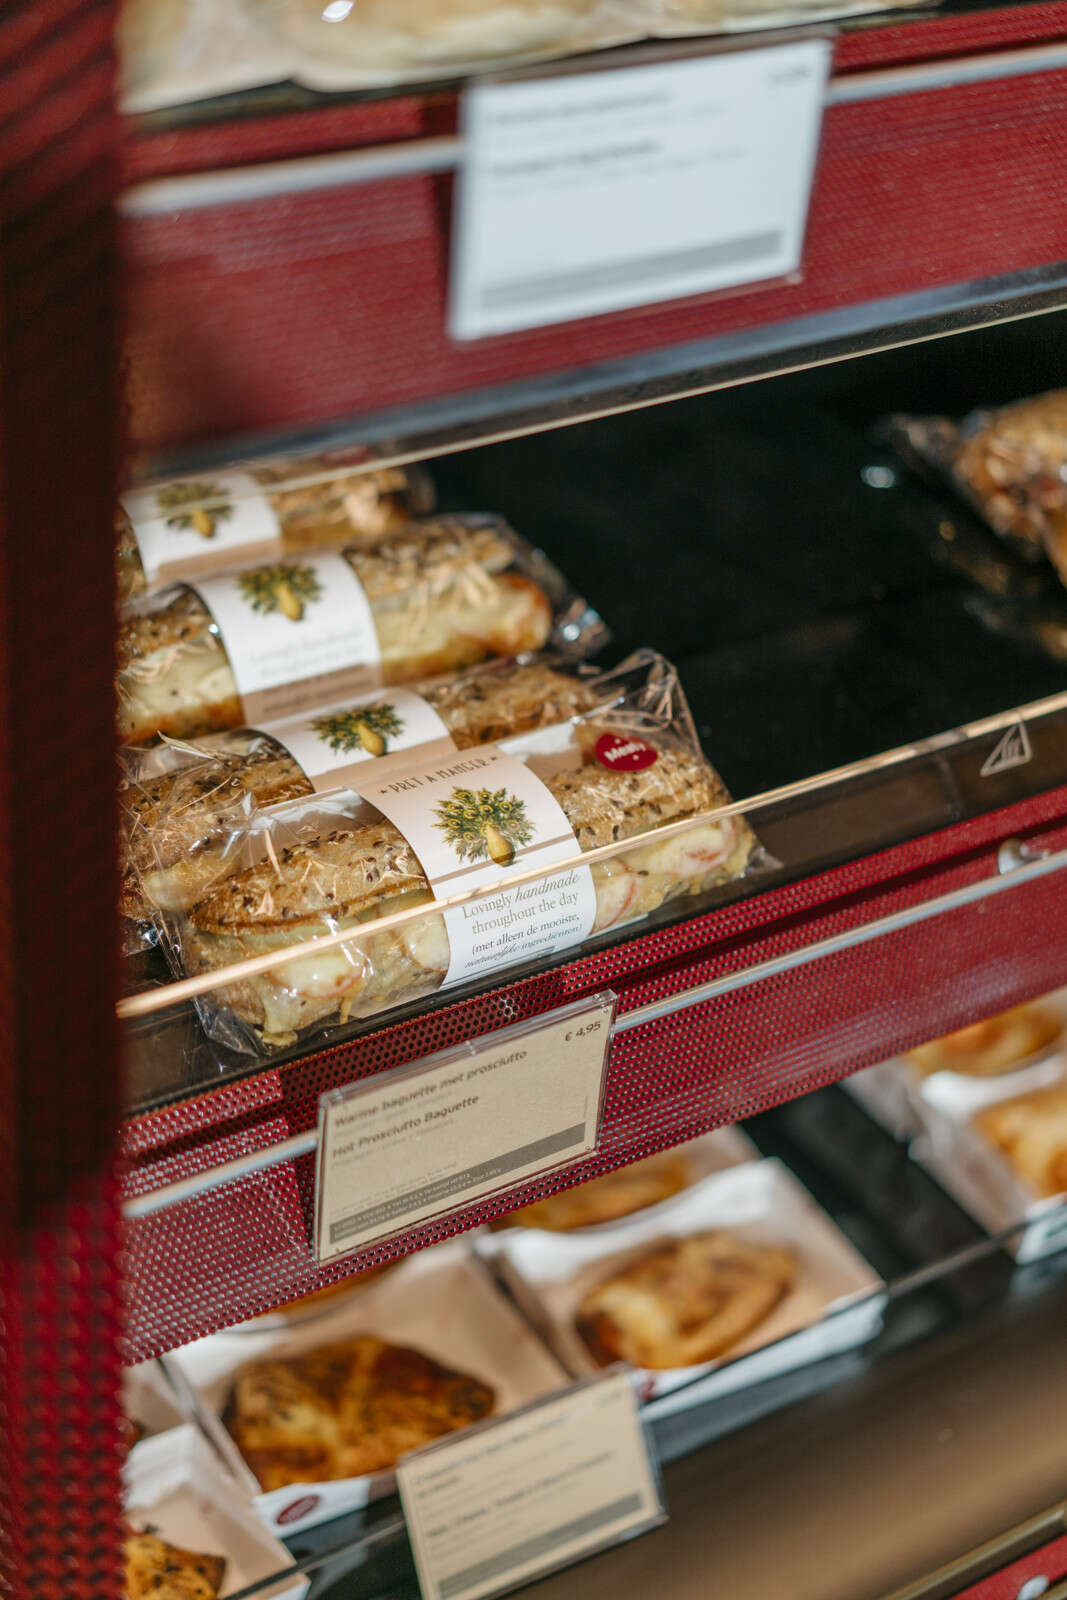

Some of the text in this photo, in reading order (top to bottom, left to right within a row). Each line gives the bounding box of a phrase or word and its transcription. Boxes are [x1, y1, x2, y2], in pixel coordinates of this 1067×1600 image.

[388, 758, 490, 793] PRET A MANGER
[462, 870, 579, 919] Lovingly handmade
[472, 892, 579, 934] throughout the day
[472, 913, 580, 956] (met alleen de mooiste,
[575, 1021, 601, 1036] 4,95
[335, 1105, 378, 1128] Warme
[381, 1084, 437, 1111] baguette
[440, 1073, 464, 1090] met
[466, 1050, 528, 1081] prosciutto
[332, 1141, 355, 1158] Hot
[358, 1117, 422, 1146] Prosciutto
[424, 1094, 480, 1123] Baguette
